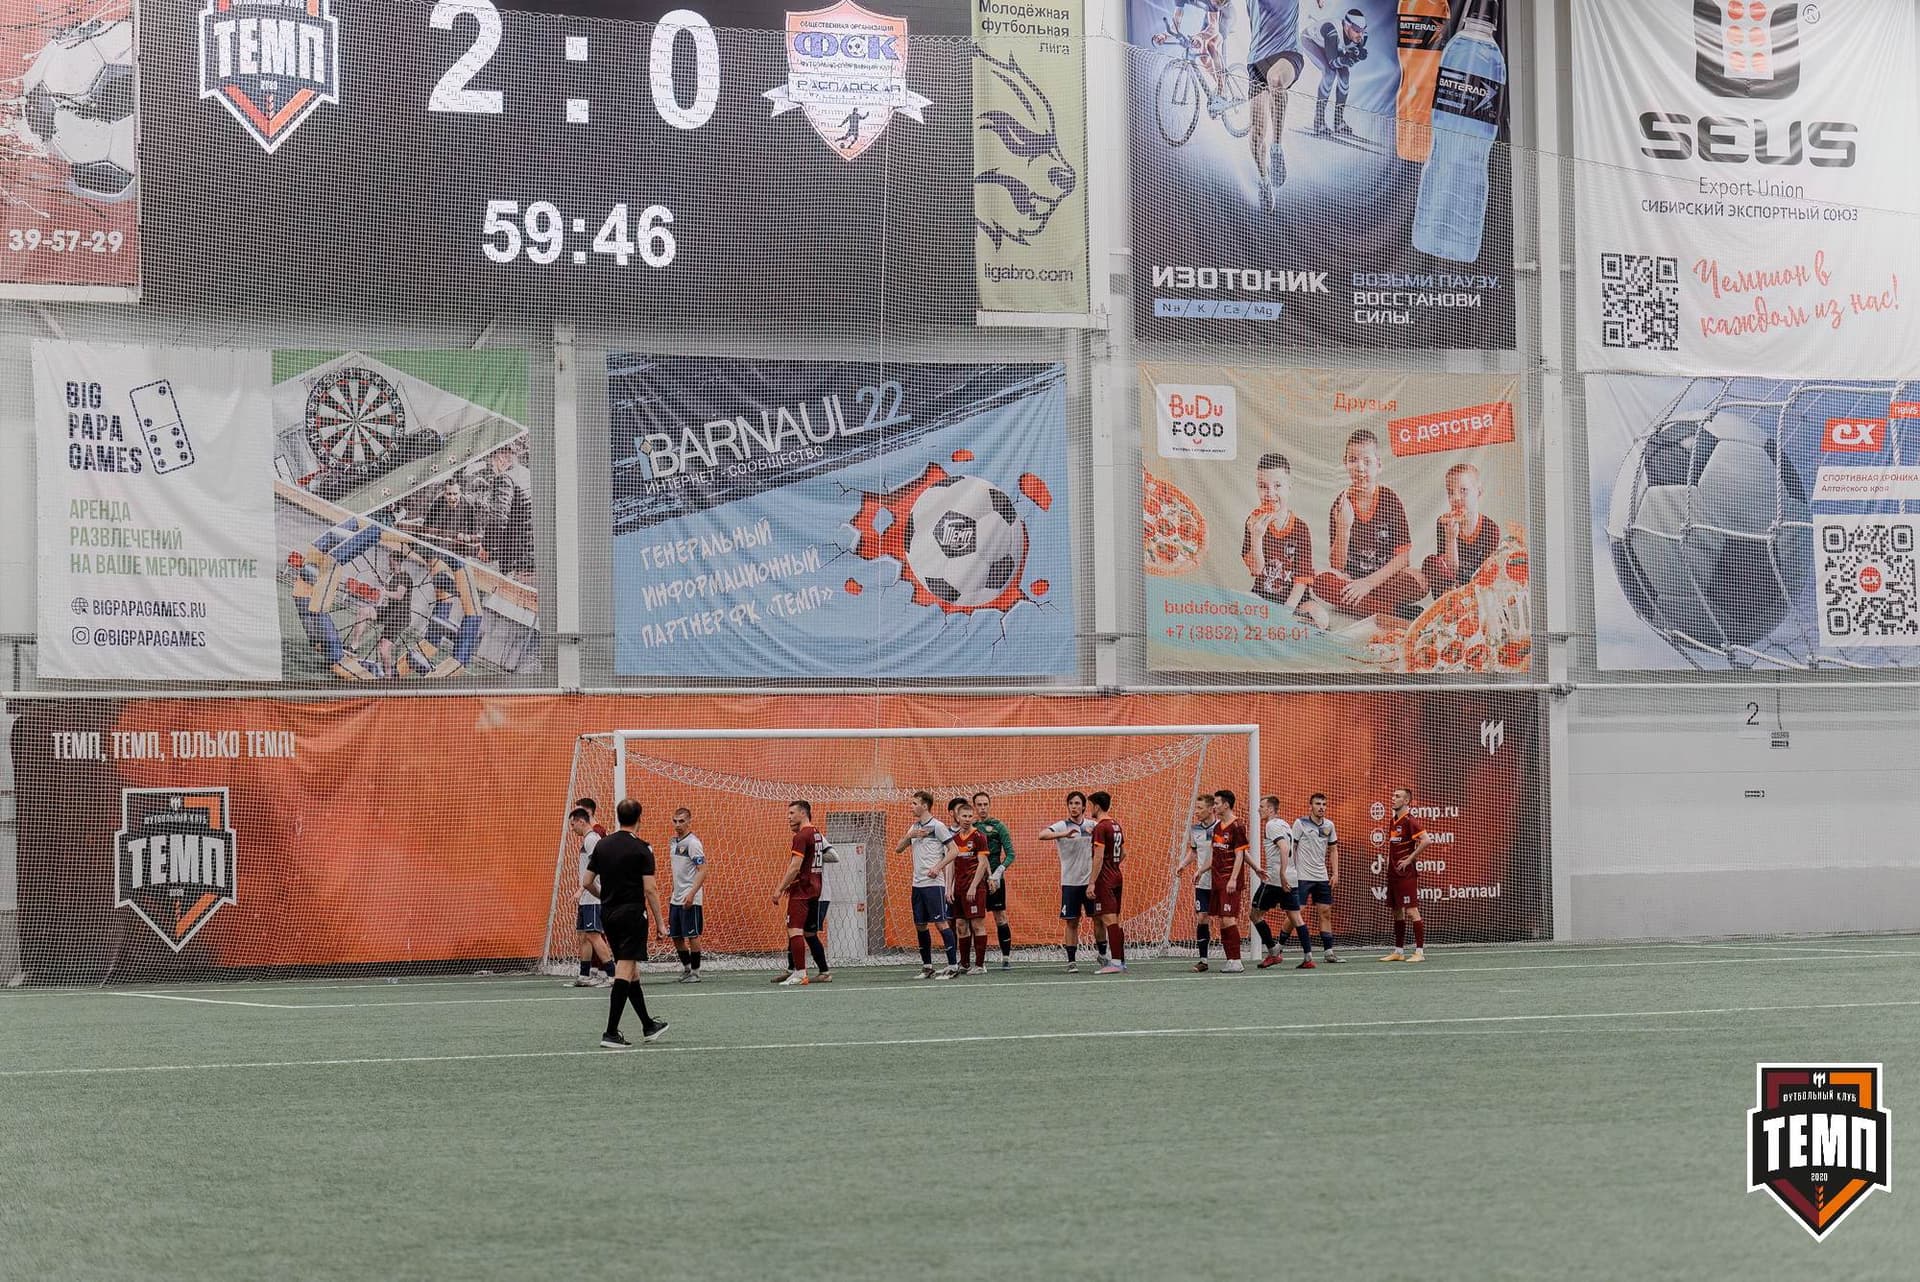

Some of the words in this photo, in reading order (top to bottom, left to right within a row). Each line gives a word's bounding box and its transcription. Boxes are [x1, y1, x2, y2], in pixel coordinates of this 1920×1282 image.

[979, 0, 1069, 20] Молодёжная
[800, 20, 849, 30] ОБЩЕСТВЕННАЯ
[982, 17, 1069, 37] футбольная
[213, 18, 325, 84] ТЕМП
[794, 31, 900, 60] ФСК
[1039, 42, 1070, 55] лига
[427, 0, 503, 114] 2
[650, 9, 720, 129] 0
[1639, 112, 1858, 167] SEUS
[1700, 176, 1750, 199] Export
[1758, 180, 1804, 199] Union
[1641, 199, 1724, 217] СИБИРСКИЙ
[1728, 204, 1819, 221] ЭКСПОРТНЫЙ
[1823, 208, 1858, 221] СОЮЗ
[8, 228, 124, 254] 39-57-29
[482, 200, 677, 267] 59:46
[984, 263, 1073, 283] ligabro.com
[1152, 265, 1330, 293] ИЗОТОНИК
[1352, 272, 1433, 288] ВОЗЬМИ
[1693, 258, 1810, 298] Чемпион
[1815, 250, 1832, 286] в
[1353, 292, 1481, 308] ВОССТАНОВИ
[1699, 295, 1810, 338] каждом
[1815, 299, 1845, 329] из
[1850, 273, 1899, 314] нас!
[1355, 310, 1414, 325] СИЛЫ.
[66, 381, 102, 409] BIG
[1169, 394, 1223, 419] BuDu
[1334, 392, 1397, 414] Друзья
[68, 412, 123, 442] PAPA
[1172, 421, 1224, 437] FOOD
[1400, 429, 1411, 442] с
[1416, 413, 1493, 442] детства
[69, 443, 143, 474] GAMES
[644, 469, 717, 495] ИНТЕРНЕТ
[729, 445, 824, 477] СООБЩЕСТВО
[1821, 484, 1868, 493] Алтайского
[1823, 473, 1879, 482] СПОРТИВНАЯ
[70, 499, 131, 523] АРЕНДА
[70, 526, 182, 550] РАЗВЛЕЧЕНИЙ
[640, 516, 773, 570] ГЕНЕРАЛЬНЫЙ
[70, 553, 91, 574] НА
[96, 554, 141, 575] ВАШЕ
[145, 556, 257, 578] МЕРОПРИЯТИЕ
[641, 544, 821, 611] ИНФОРМАЦИОННЫЙ
[92, 600, 206, 618] BIGPAPAGAMES.RU
[641, 609, 724, 648] ПАРТНЕР
[729, 600, 762, 626] ФК
[766, 585, 834, 617] «ТЕМП»
[1164, 600, 1269, 619] budufood.org
[94, 628, 206, 647] @BIGPAPAGAMES
[1166, 625, 1184, 639] +7
[1189, 625, 1239, 643] (3852)
[1746, 702, 1759, 725] 2
[52, 732, 106, 762] ТЕМП,
[111, 731, 165, 761] ТЕМП,
[170, 731, 240, 759] ТОЛЬКО
[245, 730, 296, 758] ТЕМП!
[128, 834, 224, 888] ТЕМП
[1061, 904, 1067, 916] 4
